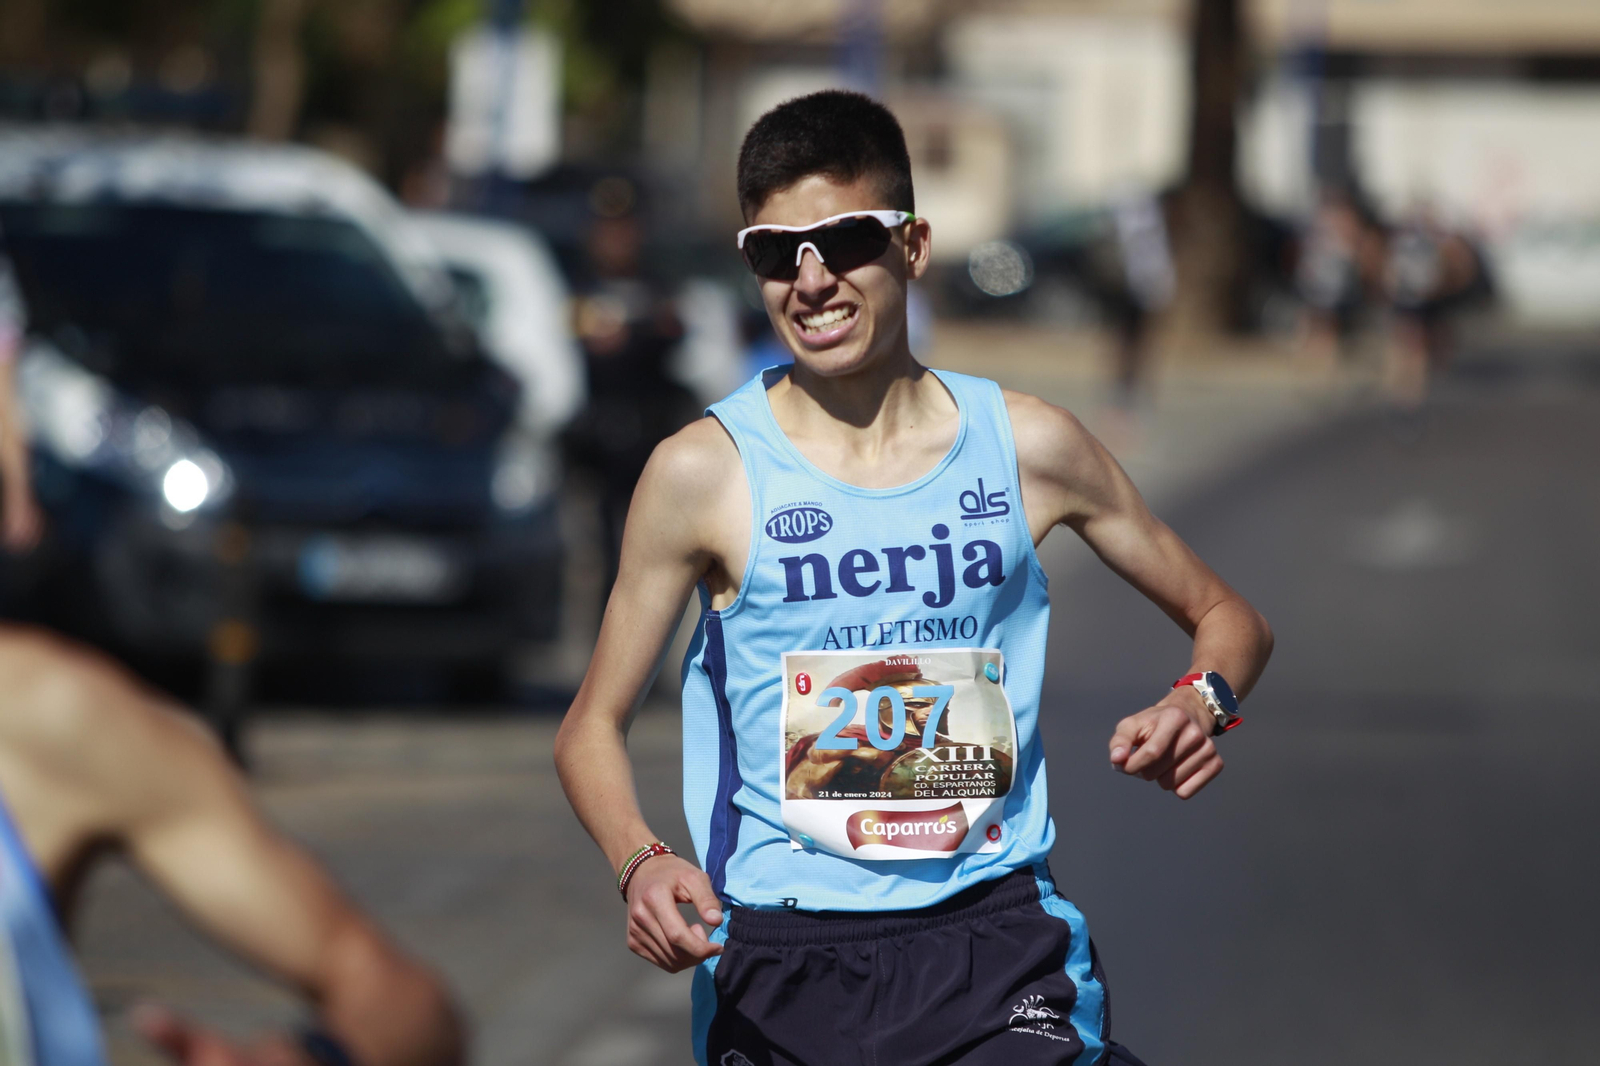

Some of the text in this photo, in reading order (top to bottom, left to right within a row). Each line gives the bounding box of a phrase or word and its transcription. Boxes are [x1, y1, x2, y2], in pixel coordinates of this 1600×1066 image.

[959, 477, 1010, 520] als
[768, 510, 831, 537] TROPS
[778, 523, 1006, 609] nerja
[822, 615, 979, 650] ATLETISMO
[815, 685, 954, 751] 207
[914, 745, 995, 762] XIII
[914, 763, 996, 773] CARRERA
[915, 772, 995, 781] POPULAR
[932, 780, 997, 789] ESPARTANOS
[942, 787, 995, 797] ALQUIÁN
[818, 790, 830, 798] 21
[831, 790, 842, 798] de
